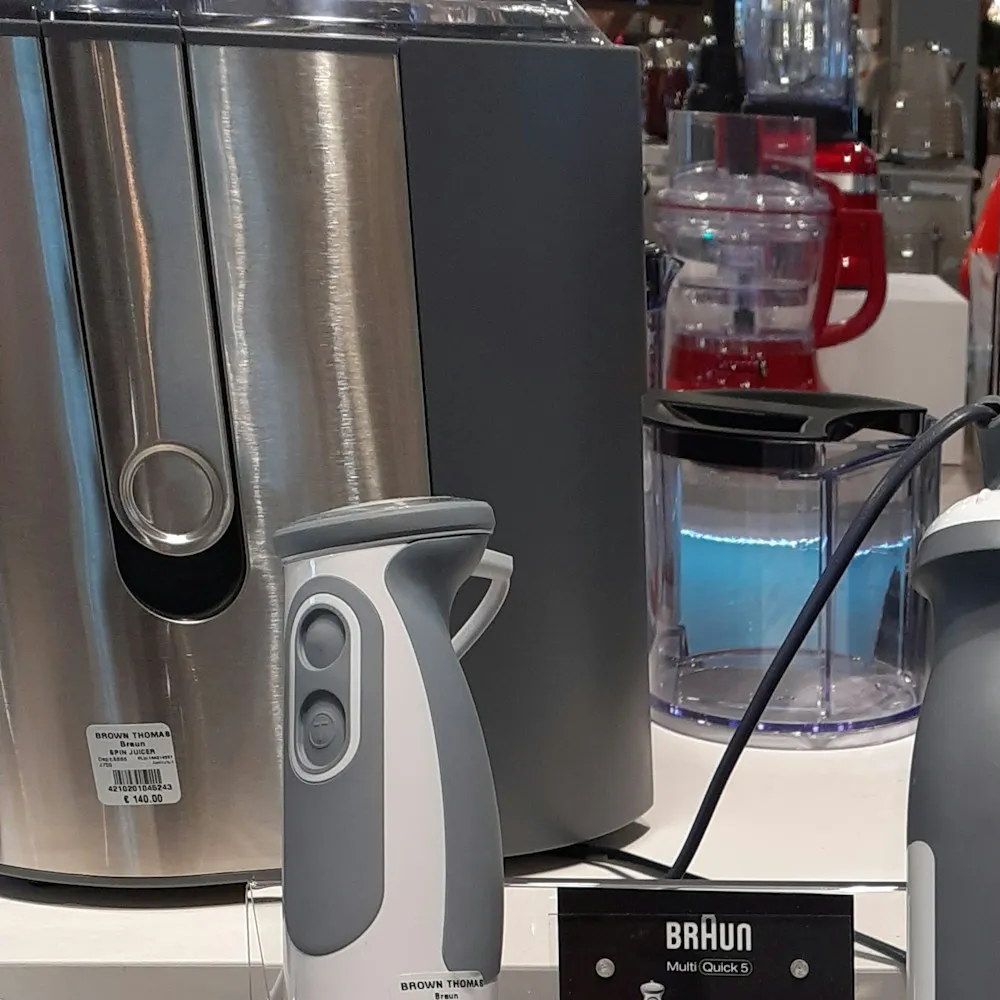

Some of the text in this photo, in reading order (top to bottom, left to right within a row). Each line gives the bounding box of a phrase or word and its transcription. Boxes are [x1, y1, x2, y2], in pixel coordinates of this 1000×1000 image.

[133, 795, 162, 803] 140.00
[667, 961, 748, 974] Multi Quick 5
[401, 979, 484, 991] BROWN THOMAS
